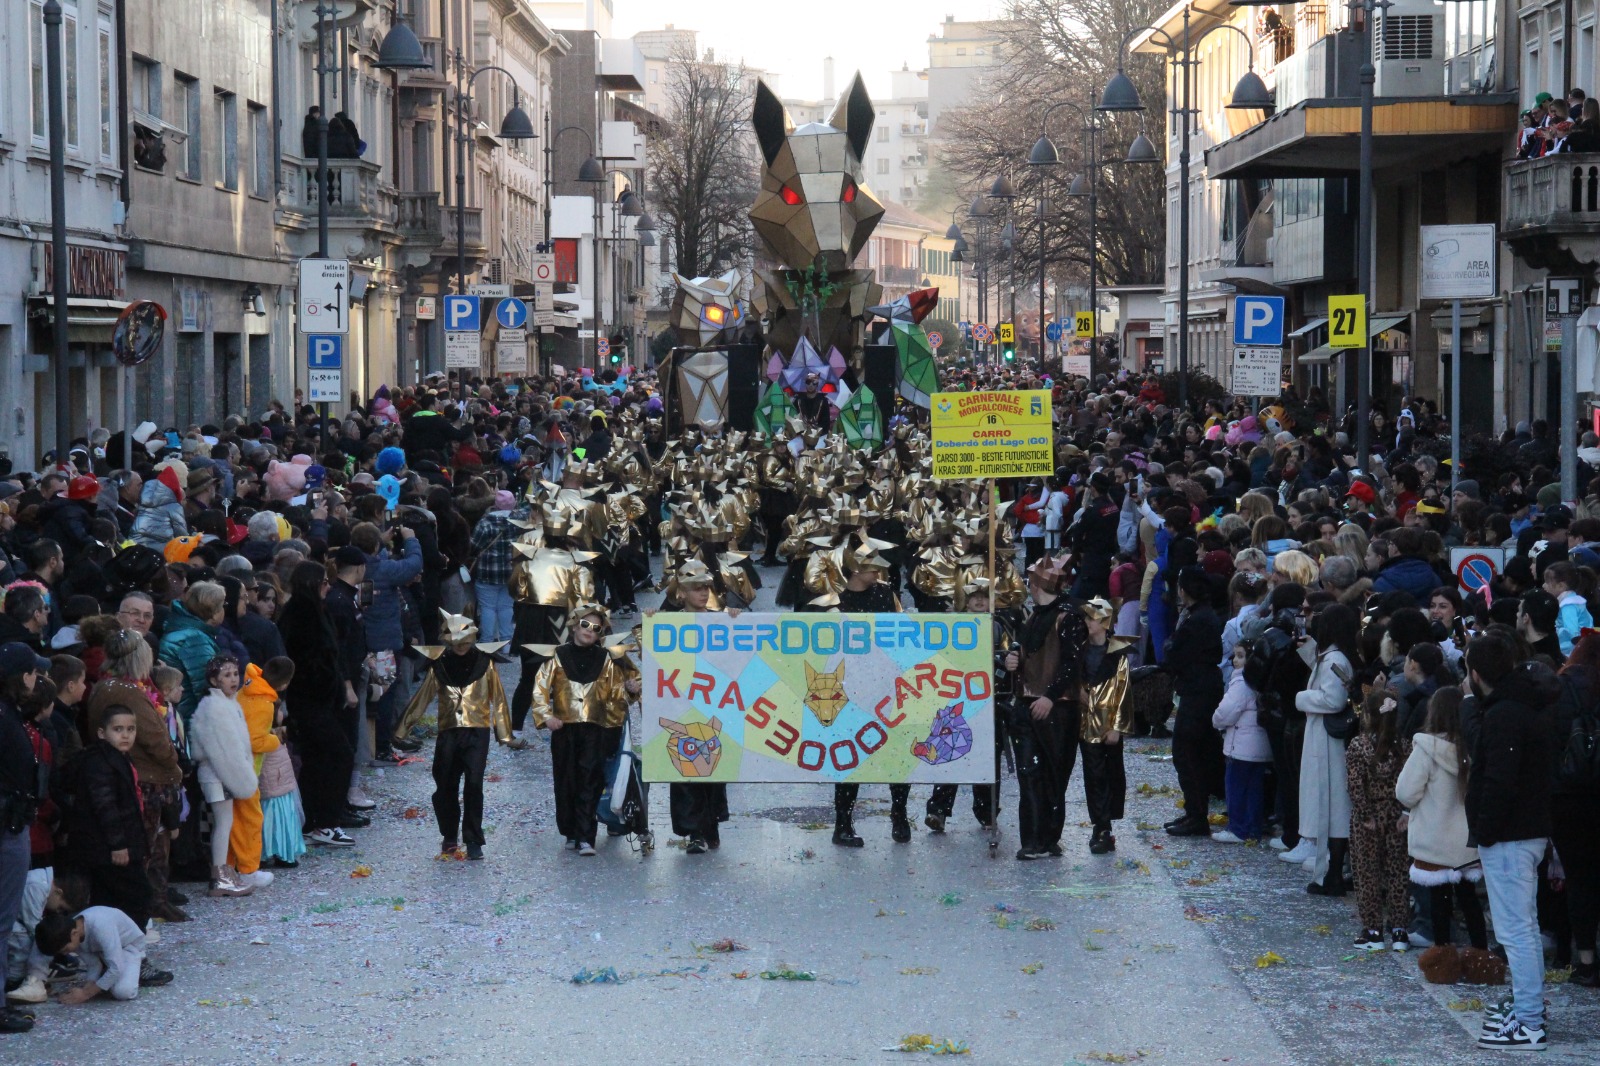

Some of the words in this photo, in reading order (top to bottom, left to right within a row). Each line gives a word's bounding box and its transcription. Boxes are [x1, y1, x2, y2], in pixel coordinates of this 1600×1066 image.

[1466, 260, 1490, 270] AREA
[1550, 280, 1579, 313] T
[451, 299, 472, 327] P
[1077, 318, 1090, 331] 26
[1244, 301, 1274, 340] P
[1332, 308, 1356, 335] 27
[1002, 329, 1011, 338] 25
[315, 339, 335, 364] P
[958, 393, 1021, 408] CARNEVALE
[958, 403, 1024, 418] MONFALCONESE
[987, 415, 996, 424] 16
[972, 430, 1011, 438] CARRO
[936, 439, 979, 448] Doberdò
[1000, 438, 1024, 447] Lago
[1028, 437, 1048, 446] (GO)
[937, 454, 958, 463] CARSO
[960, 453, 975, 462] 3000
[982, 452, 1003, 461] BESTIE
[1005, 450, 1049, 461] FUTURISTICHE
[939, 465, 956, 475] KRAS
[958, 465, 972, 474] 3000
[980, 462, 1024, 473] FUTURISTIČNE
[1025, 462, 1051, 472] ZVERINE
[656, 668, 777, 730] KRAS
[764, 718, 889, 771] 3000
[875, 662, 991, 729] CARSO
